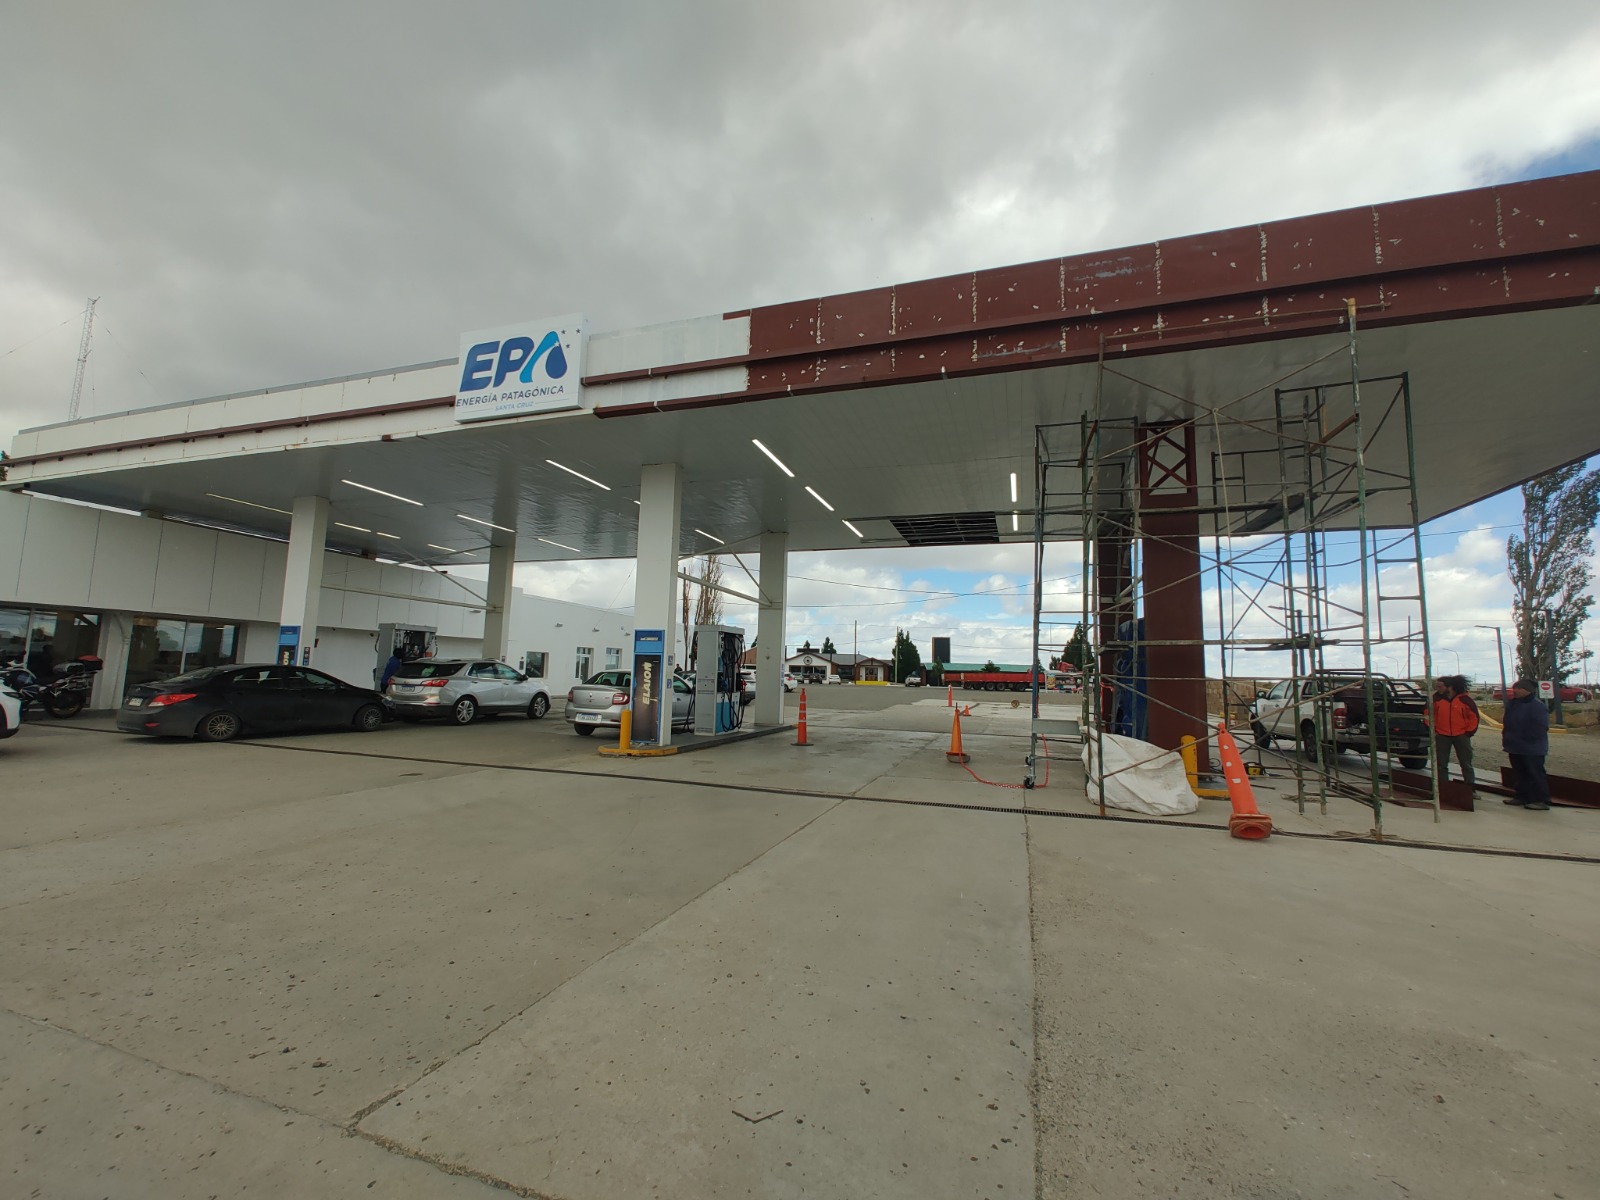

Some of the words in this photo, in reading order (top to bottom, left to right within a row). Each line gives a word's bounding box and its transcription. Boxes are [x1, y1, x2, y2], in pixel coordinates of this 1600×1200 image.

[456, 393, 497, 407] ENERGÍA
[501, 385, 564, 401] PATAGÓNICA
[495, 403, 515, 411] SANTA
[517, 401, 534, 409] CRUZ
[643, 662, 652, 704] ELAION
